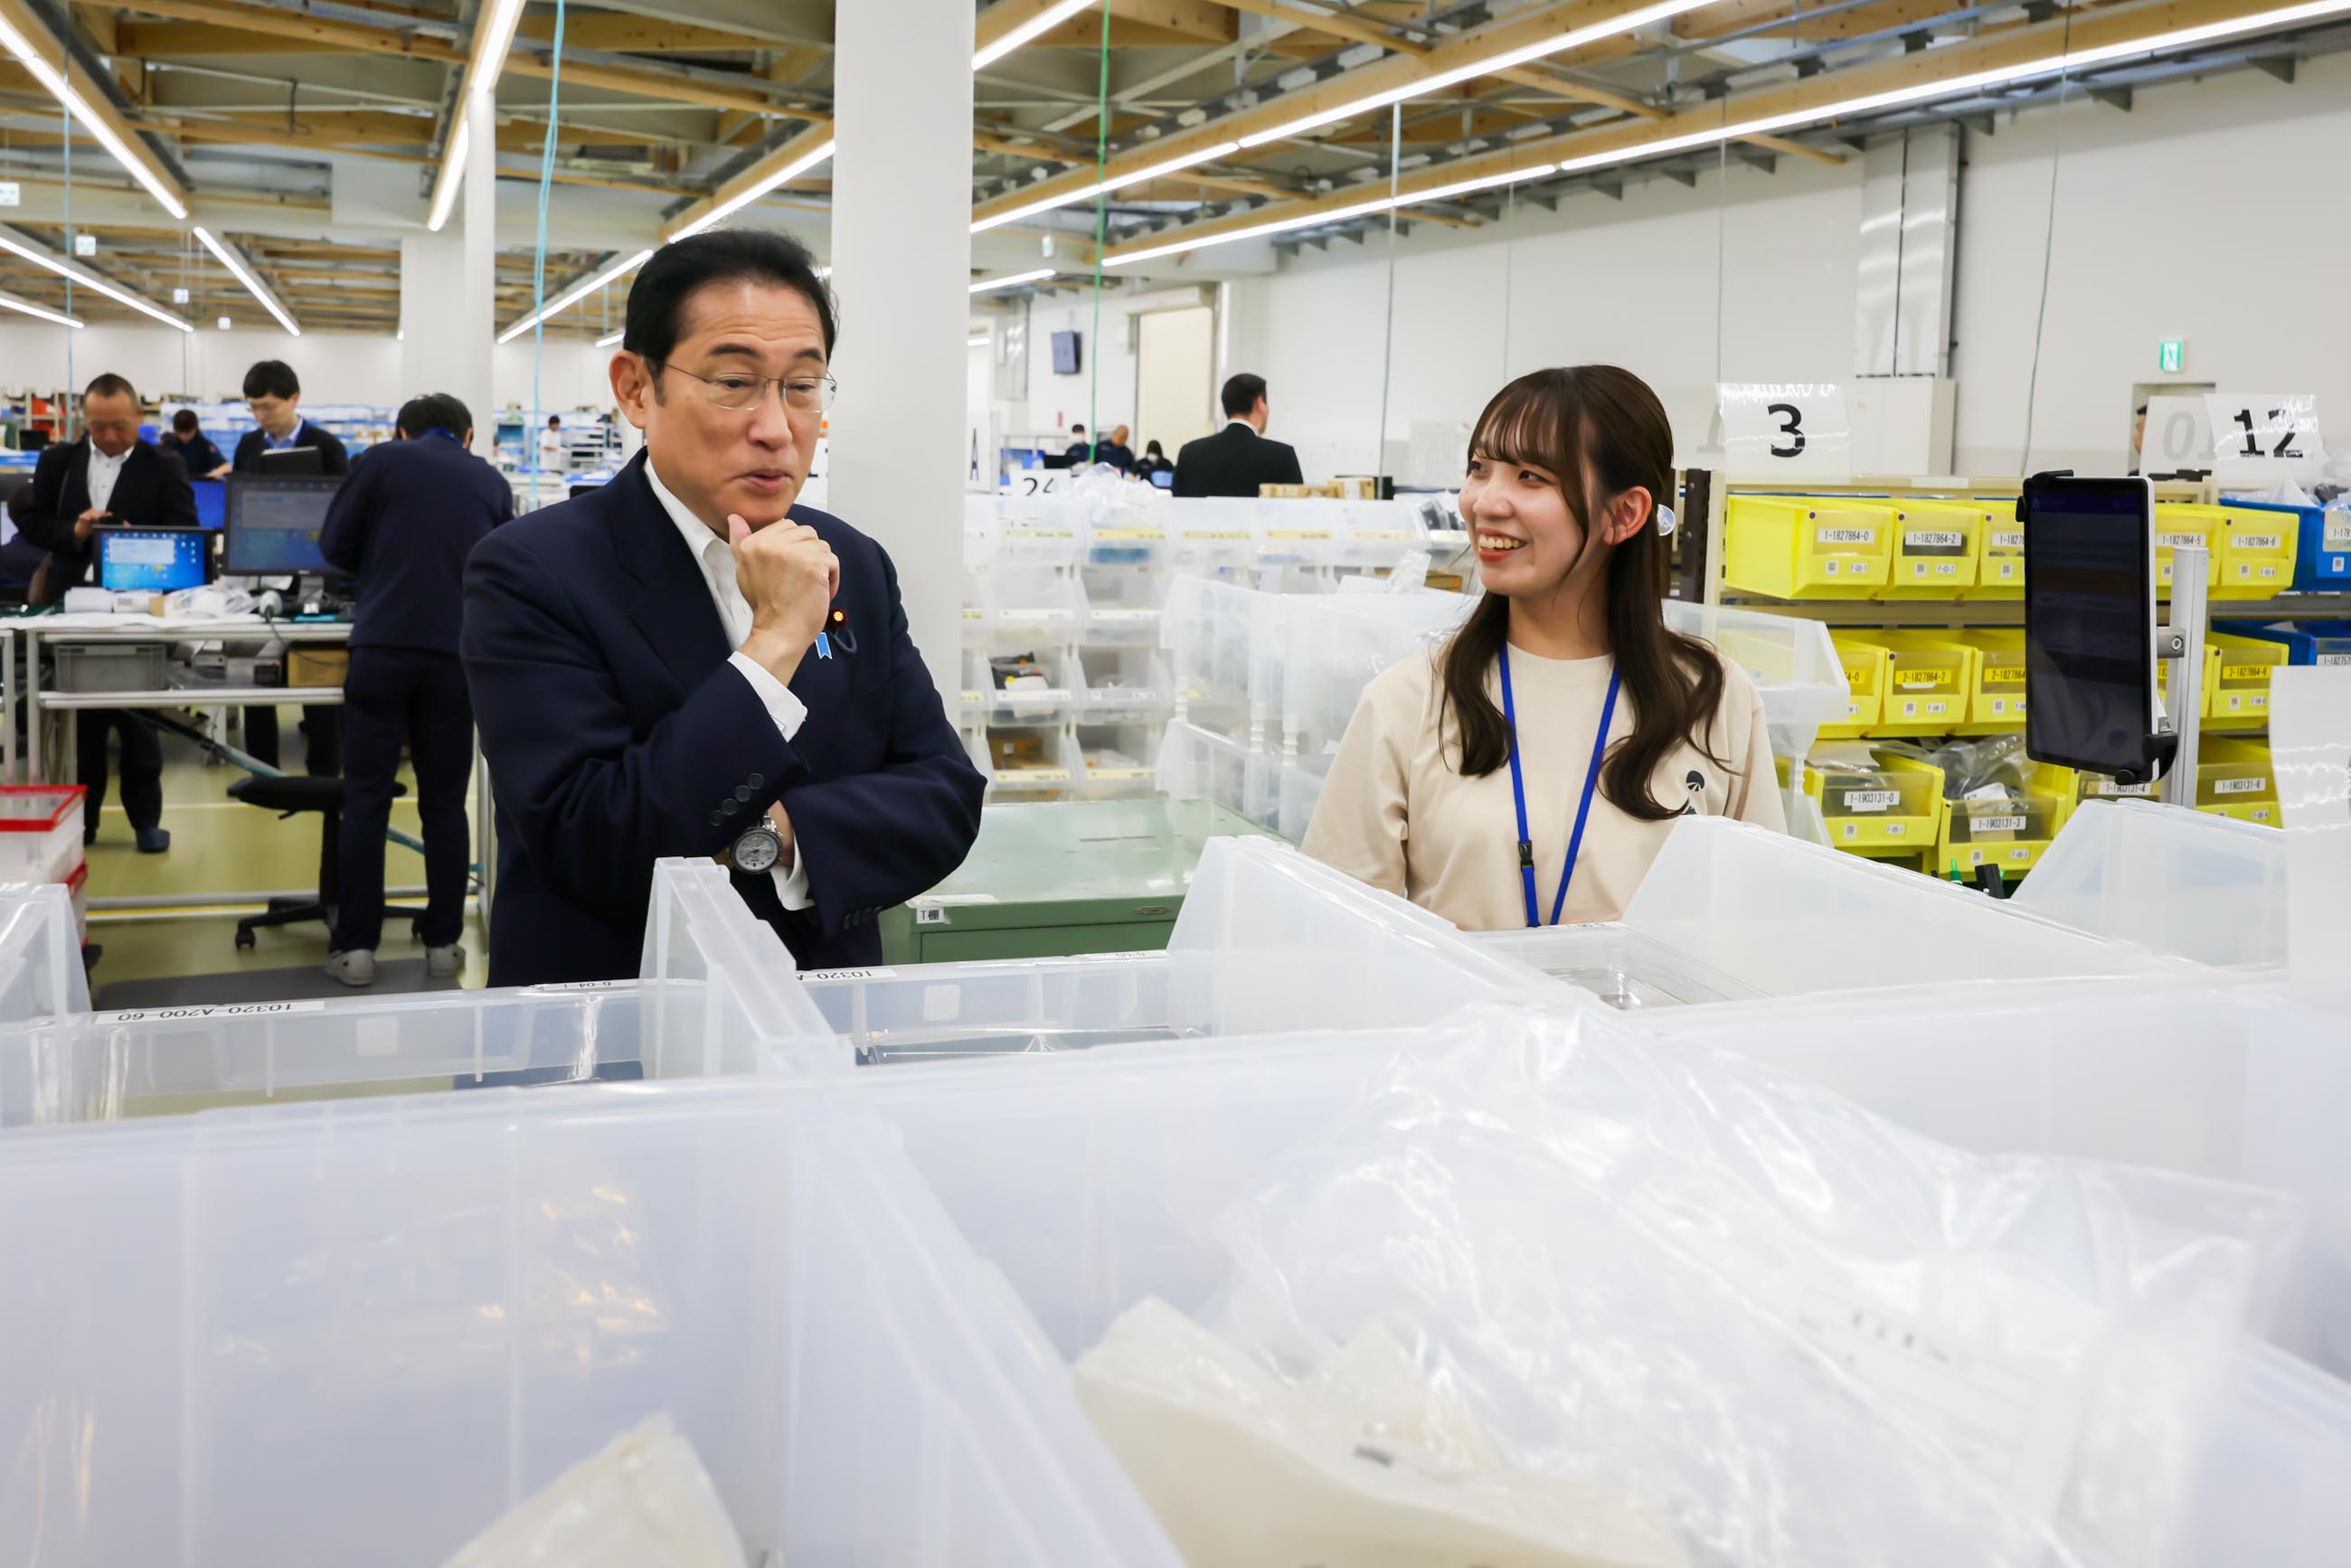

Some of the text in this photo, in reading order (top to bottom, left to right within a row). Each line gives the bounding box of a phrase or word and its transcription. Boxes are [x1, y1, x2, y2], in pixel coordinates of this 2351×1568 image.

[1768, 403, 1806, 458] 3
[2233, 409, 2304, 458] 12
[1824, 529, 1869, 542] 1-1827864-0
[1913, 533, 1956, 543] 1-1827864-2
[1903, 671, 1946, 683] 2-1827864-2
[1850, 792, 1894, 804] 1-1903131-0
[1978, 816, 2021, 829] 1-1903131-3
[118, 1003, 292, 1022] 10320-A200-60
